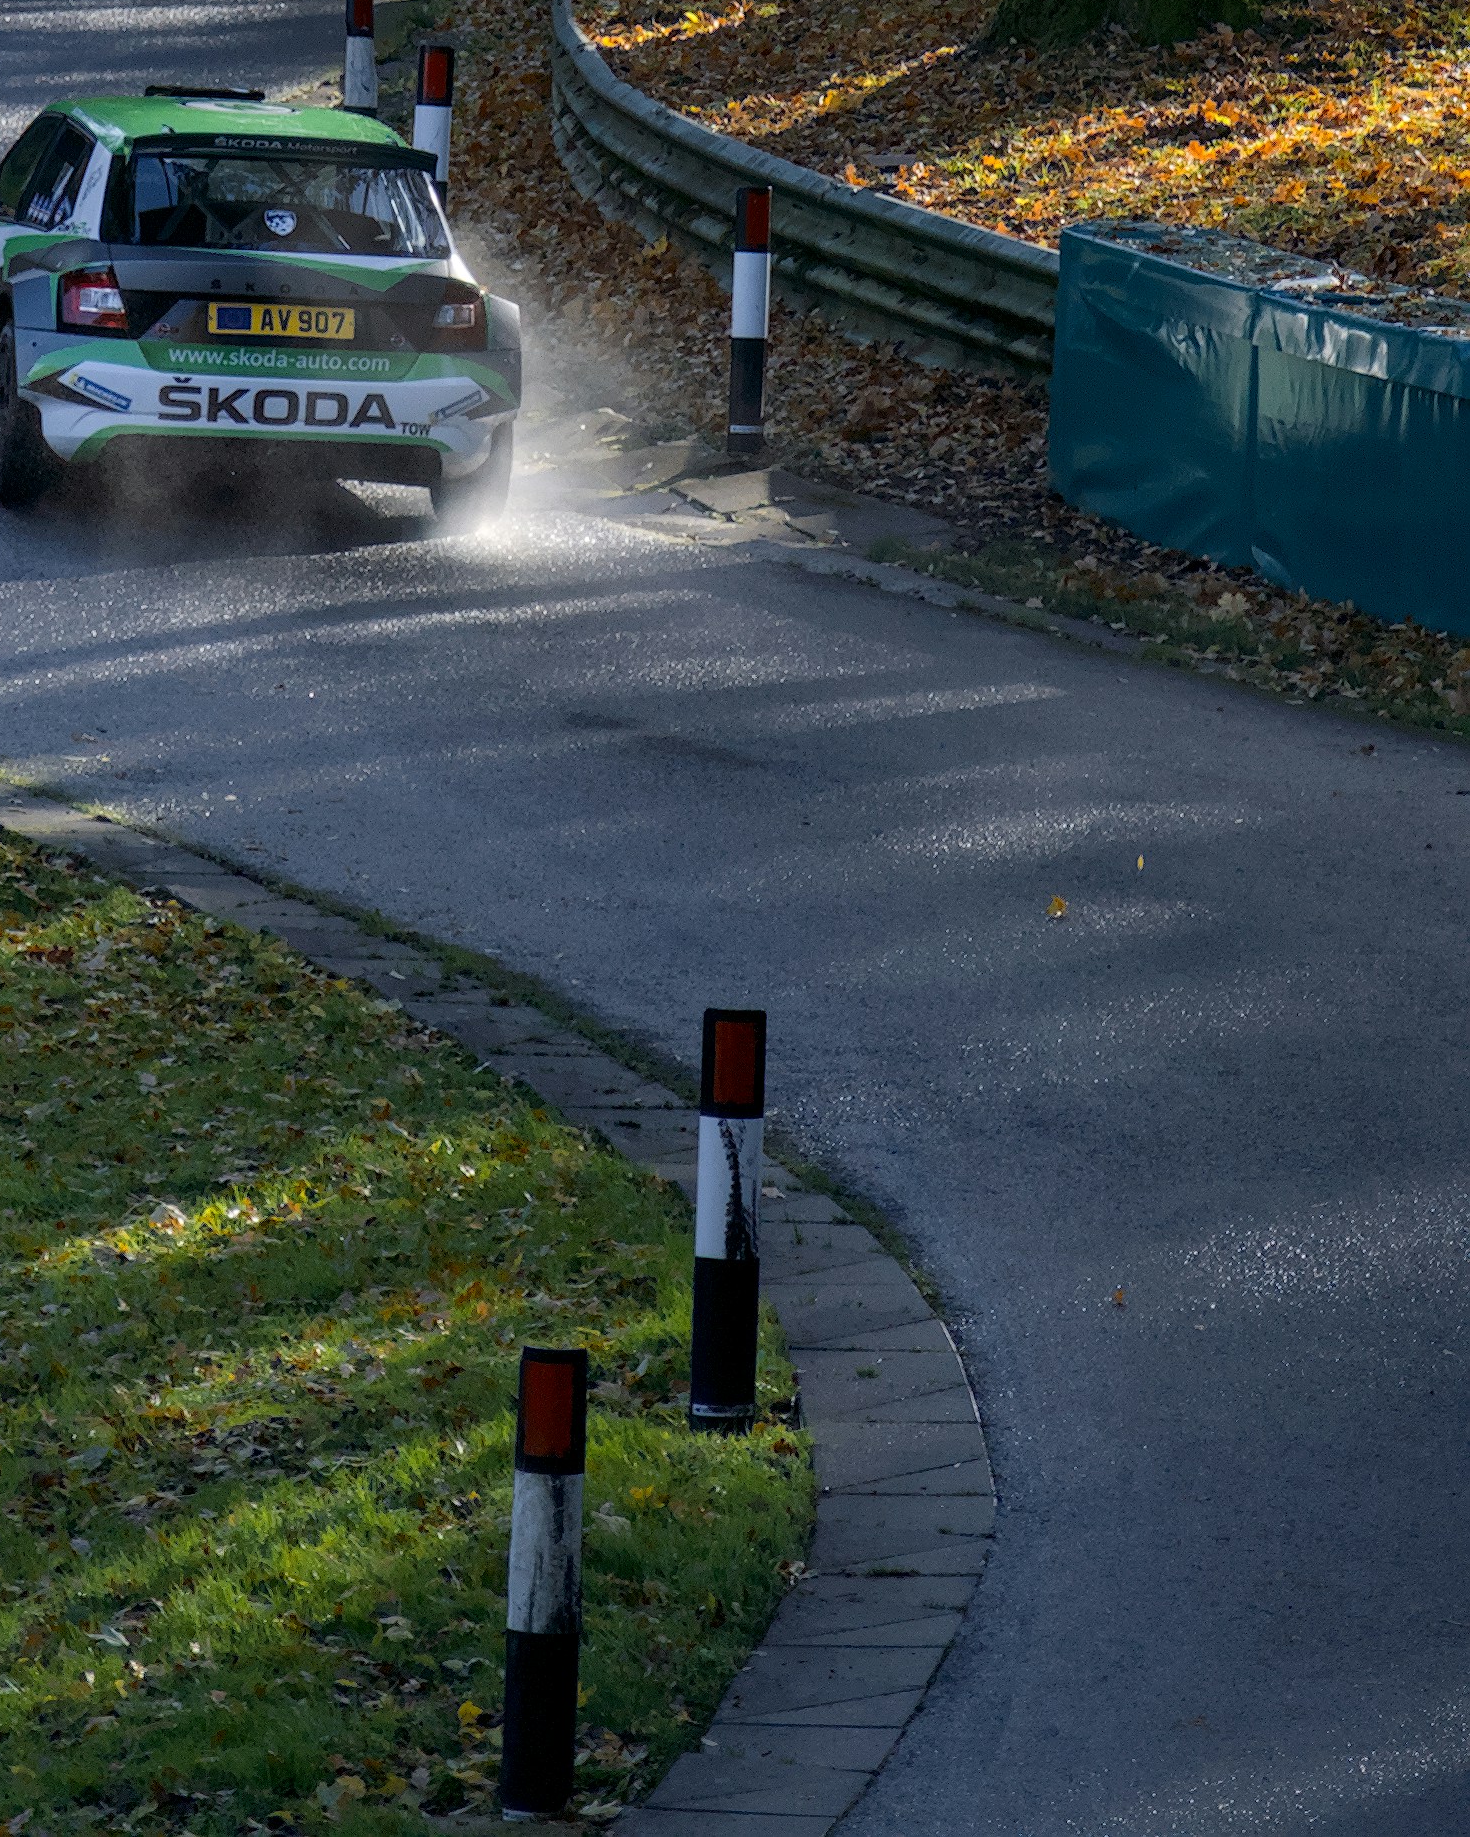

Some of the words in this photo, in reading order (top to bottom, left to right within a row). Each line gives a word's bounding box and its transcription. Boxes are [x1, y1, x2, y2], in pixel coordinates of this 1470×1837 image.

[260, 308, 292, 332] AV
[298, 309, 346, 335] 907
[168, 347, 391, 372] www.skoda-auto.com
[158, 376, 397, 430] ŠKODA
[400, 422, 432, 436] TOW
